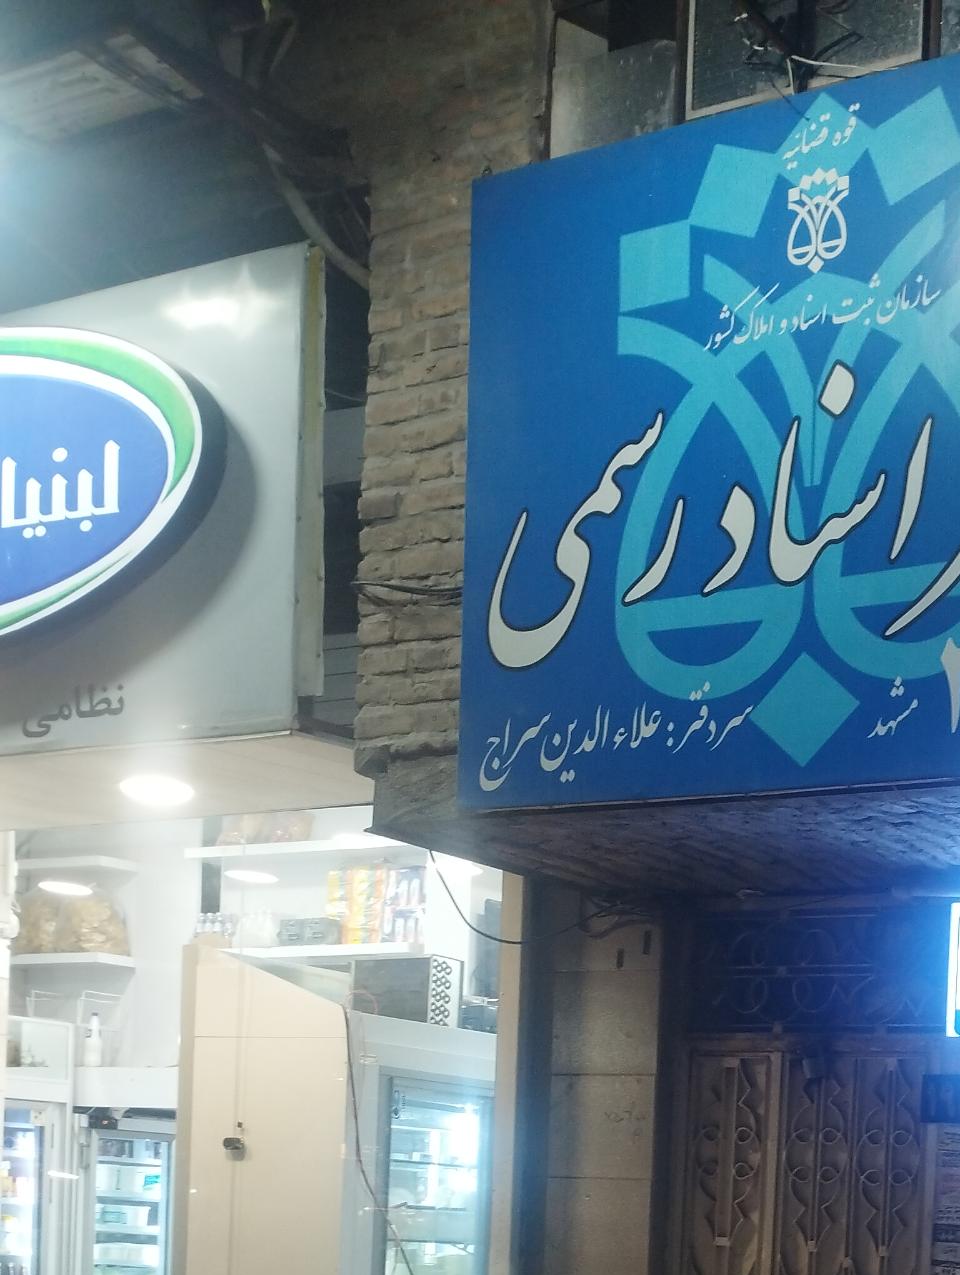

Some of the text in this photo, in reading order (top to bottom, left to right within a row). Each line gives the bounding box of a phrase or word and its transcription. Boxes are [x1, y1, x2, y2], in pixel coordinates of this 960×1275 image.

[832, 102, 861, 147] قوه
[704, 273, 942, 350] سازمان ثبت اسناد و املاک کشور
[0, 439, 121, 539] لبنیا
[703, 359, 934, 597] اسناد
[487, 410, 687, 668] رسمی
[21, 683, 126, 739] نظامی
[539, 704, 611, 783] الدین
[612, 701, 663, 750] علاء
[867, 675, 919, 739] مشهد
[479, 711, 552, 792] سراج
